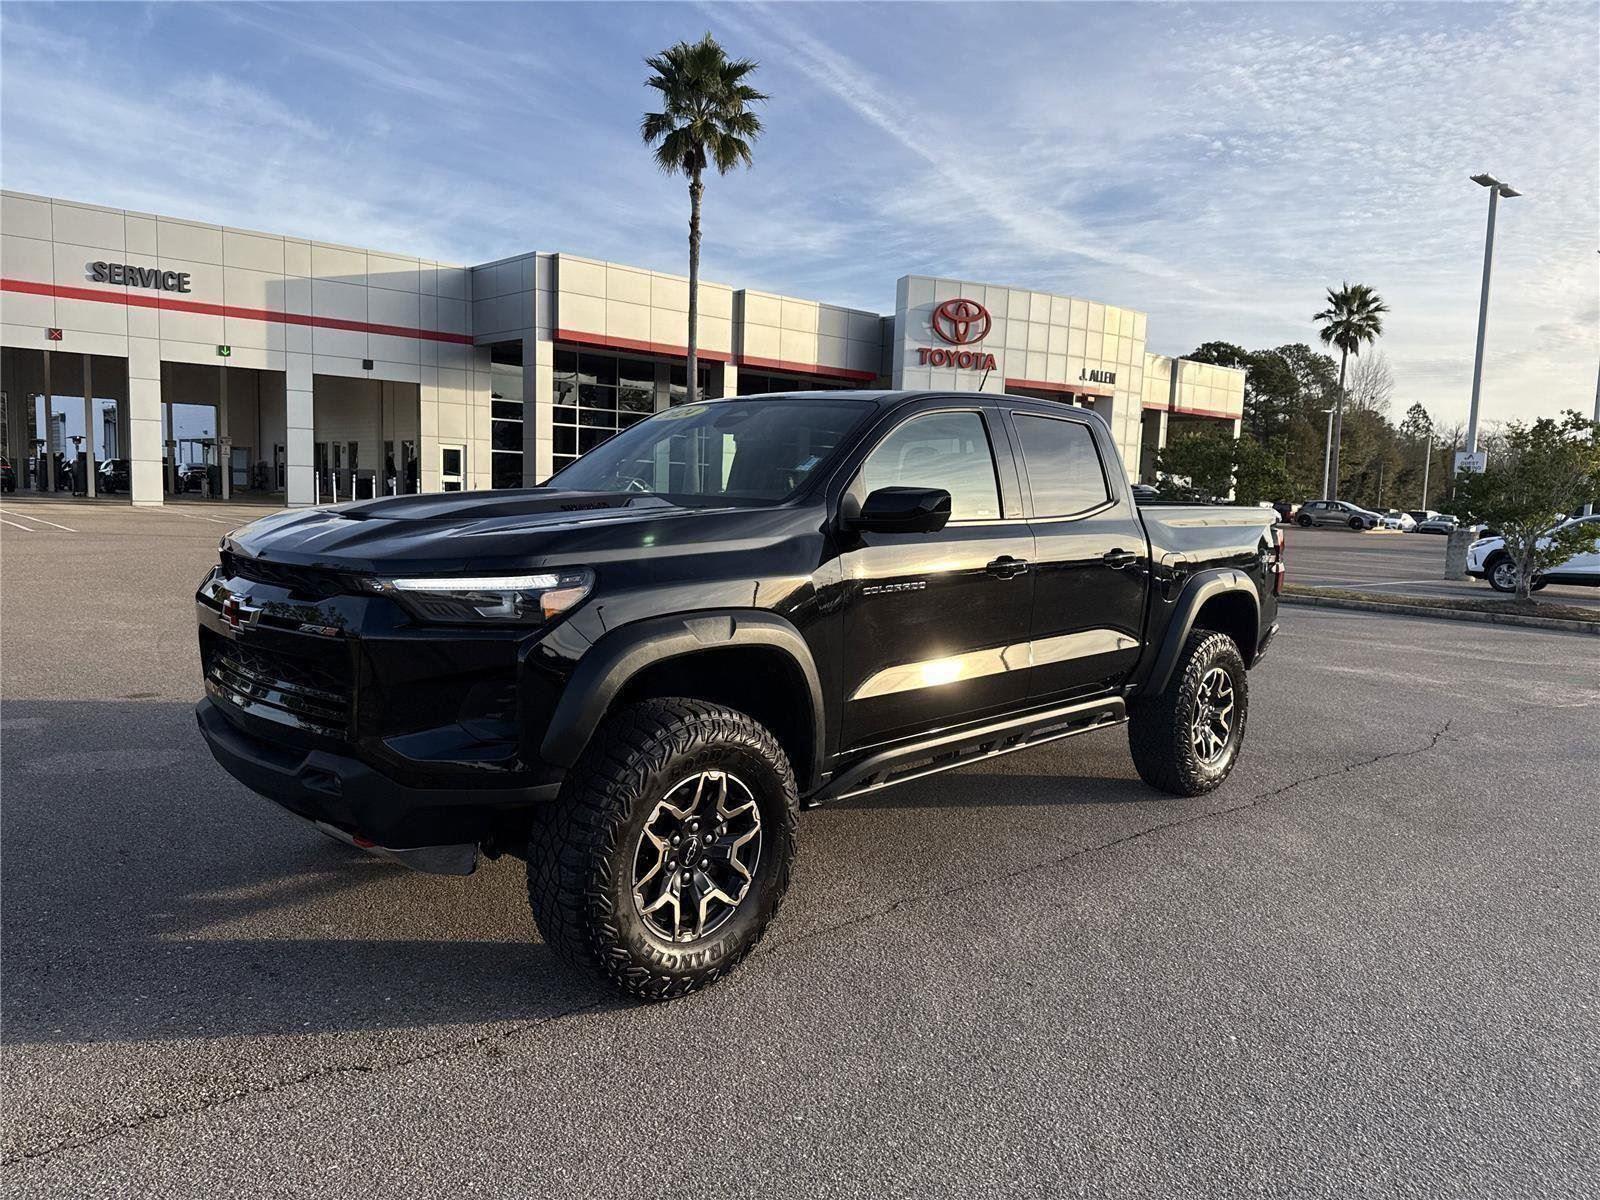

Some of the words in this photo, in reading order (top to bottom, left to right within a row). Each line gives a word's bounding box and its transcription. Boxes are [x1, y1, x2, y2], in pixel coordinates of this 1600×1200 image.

[91, 261, 191, 293] SERVICE
[917, 348, 997, 370] TOYOTA
[1079, 368, 1088, 381] J.
[1089, 369, 1116, 384] ALLEN
[862, 581, 926, 595] COLORADO
[633, 931, 740, 969] WRANGLER
